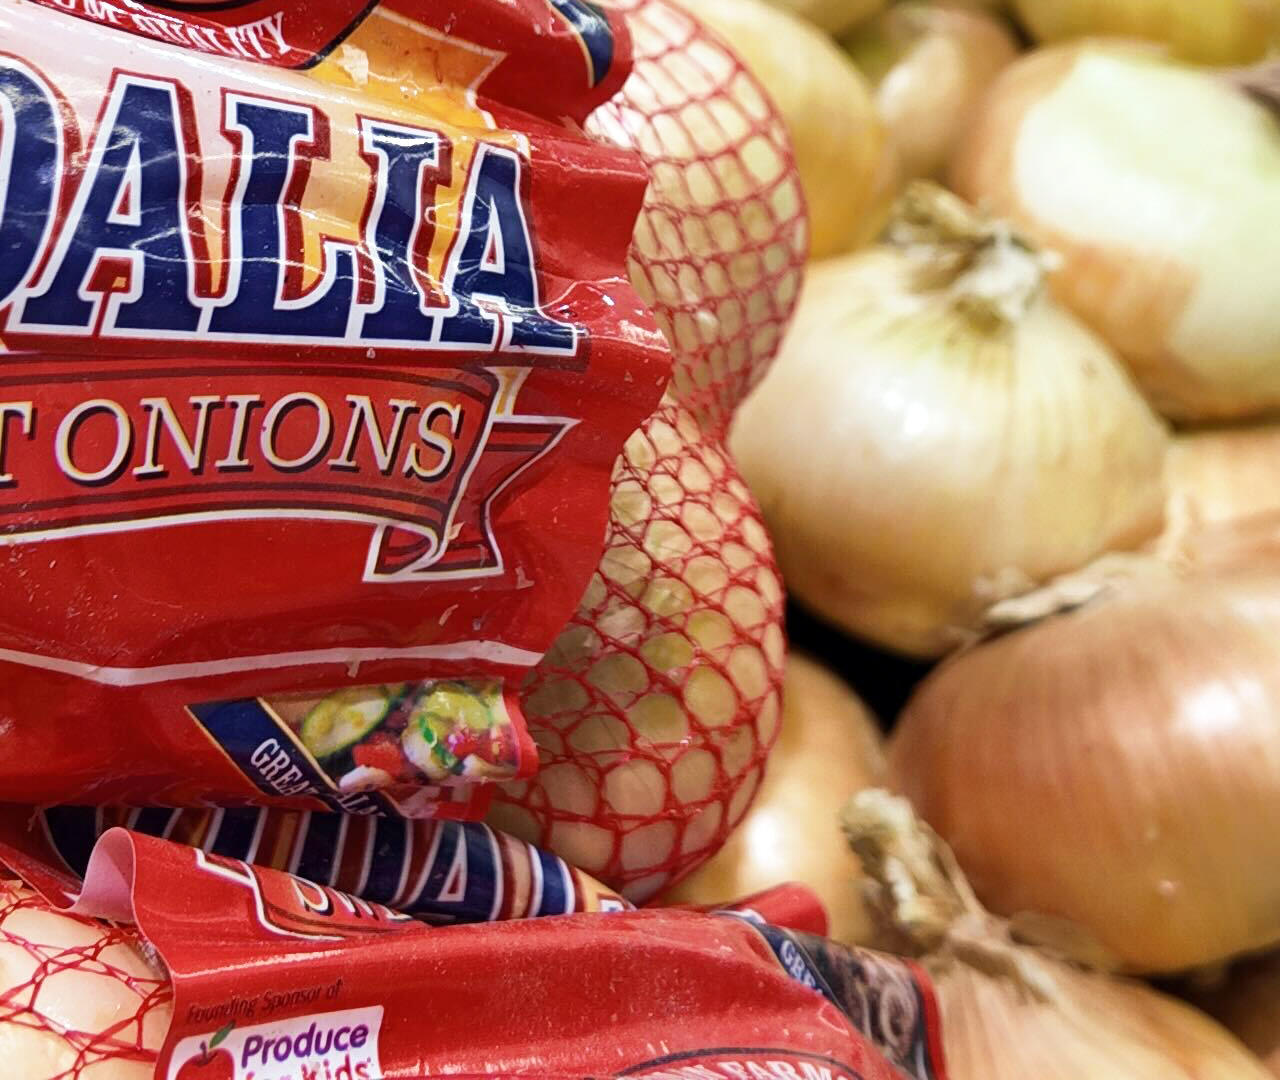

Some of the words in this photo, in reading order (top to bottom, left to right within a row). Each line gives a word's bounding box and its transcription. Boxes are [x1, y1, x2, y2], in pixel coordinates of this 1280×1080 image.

[133, 10, 293, 60] QUALITY
[54, 392, 464, 488] ONIONS
[780, 939, 824, 994] GRE
[185, 995, 257, 1025] Founding
[260, 984, 324, 1011] Sponsor
[325, 977, 345, 999] of
[241, 1021, 370, 1069] Produce
